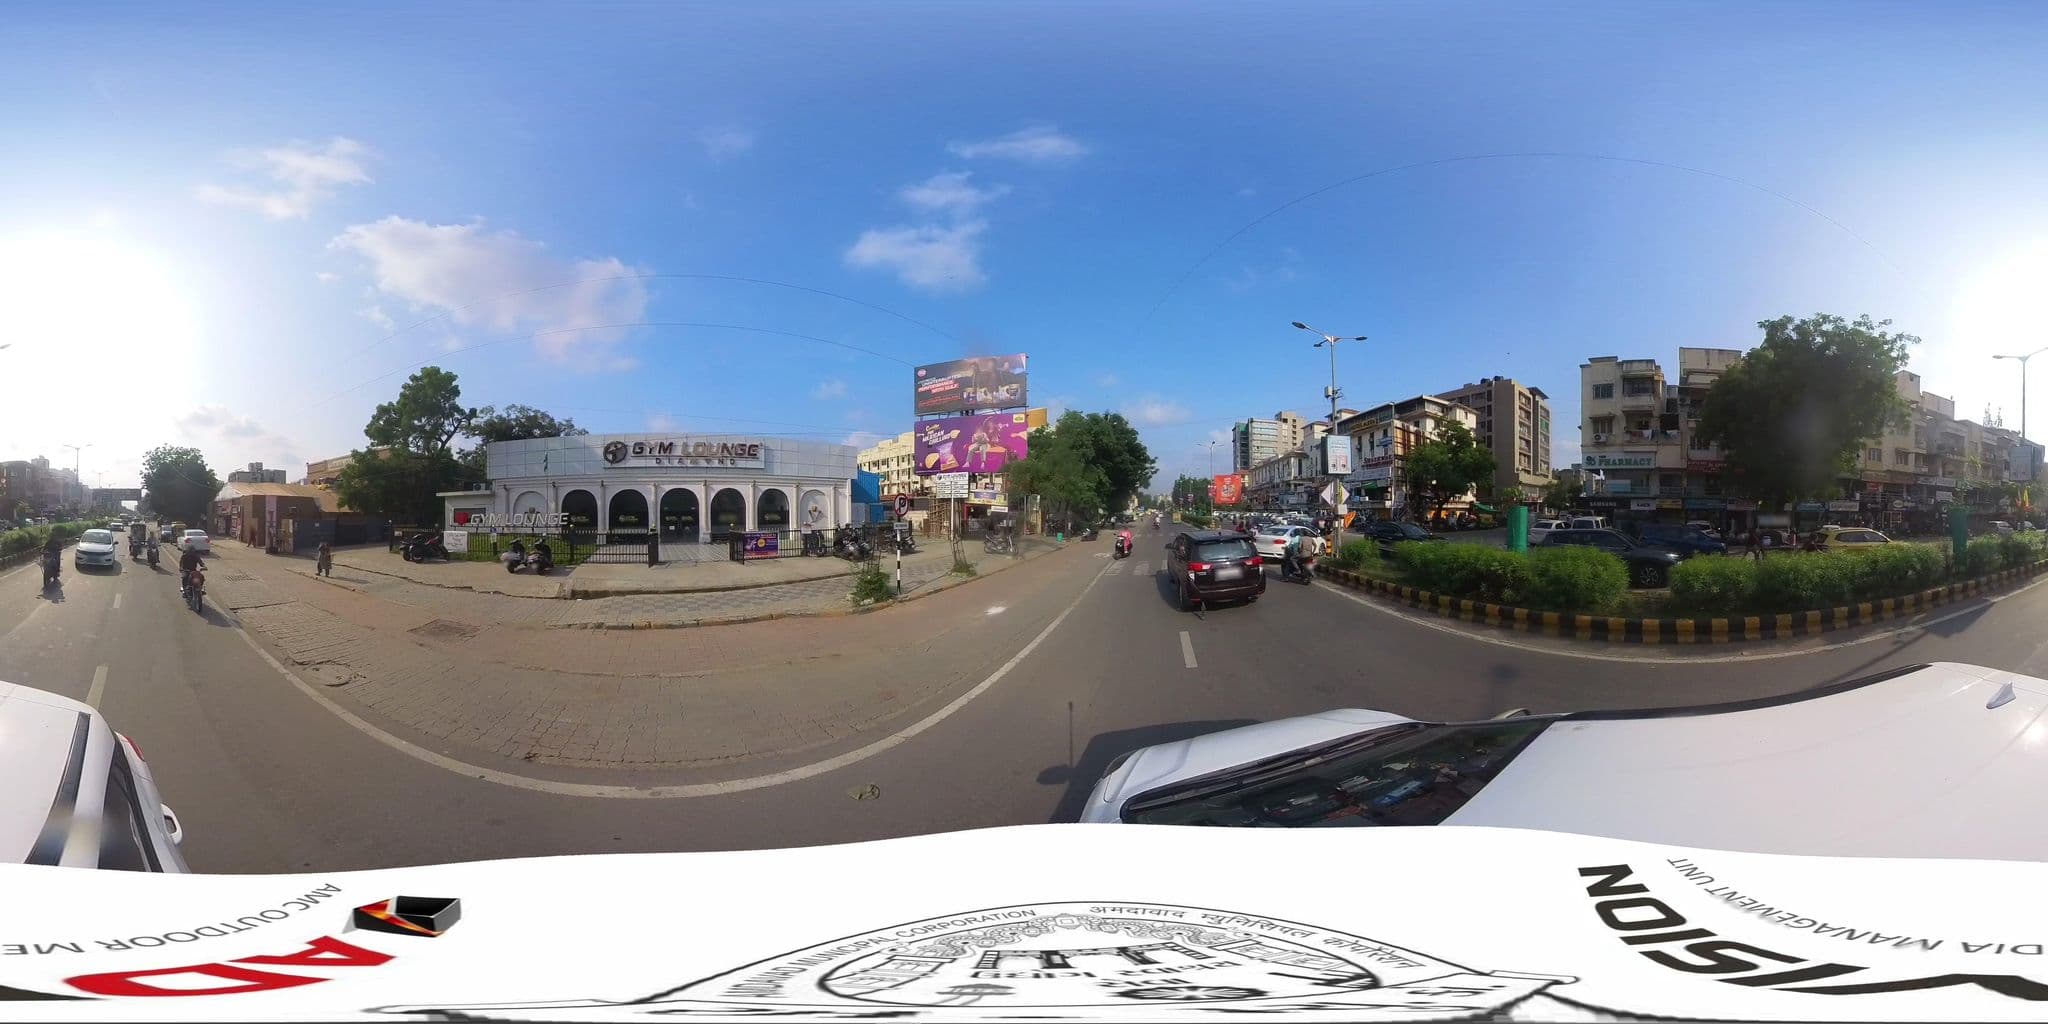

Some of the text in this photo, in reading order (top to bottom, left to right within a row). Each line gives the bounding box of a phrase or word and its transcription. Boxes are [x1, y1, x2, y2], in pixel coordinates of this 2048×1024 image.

[632, 441, 760, 457] GYM LOUNGE
[1598, 456, 1652, 466] PHARMACY
[471, 513, 504, 525] GYM
[506, 513, 570, 526] LOUNGE
